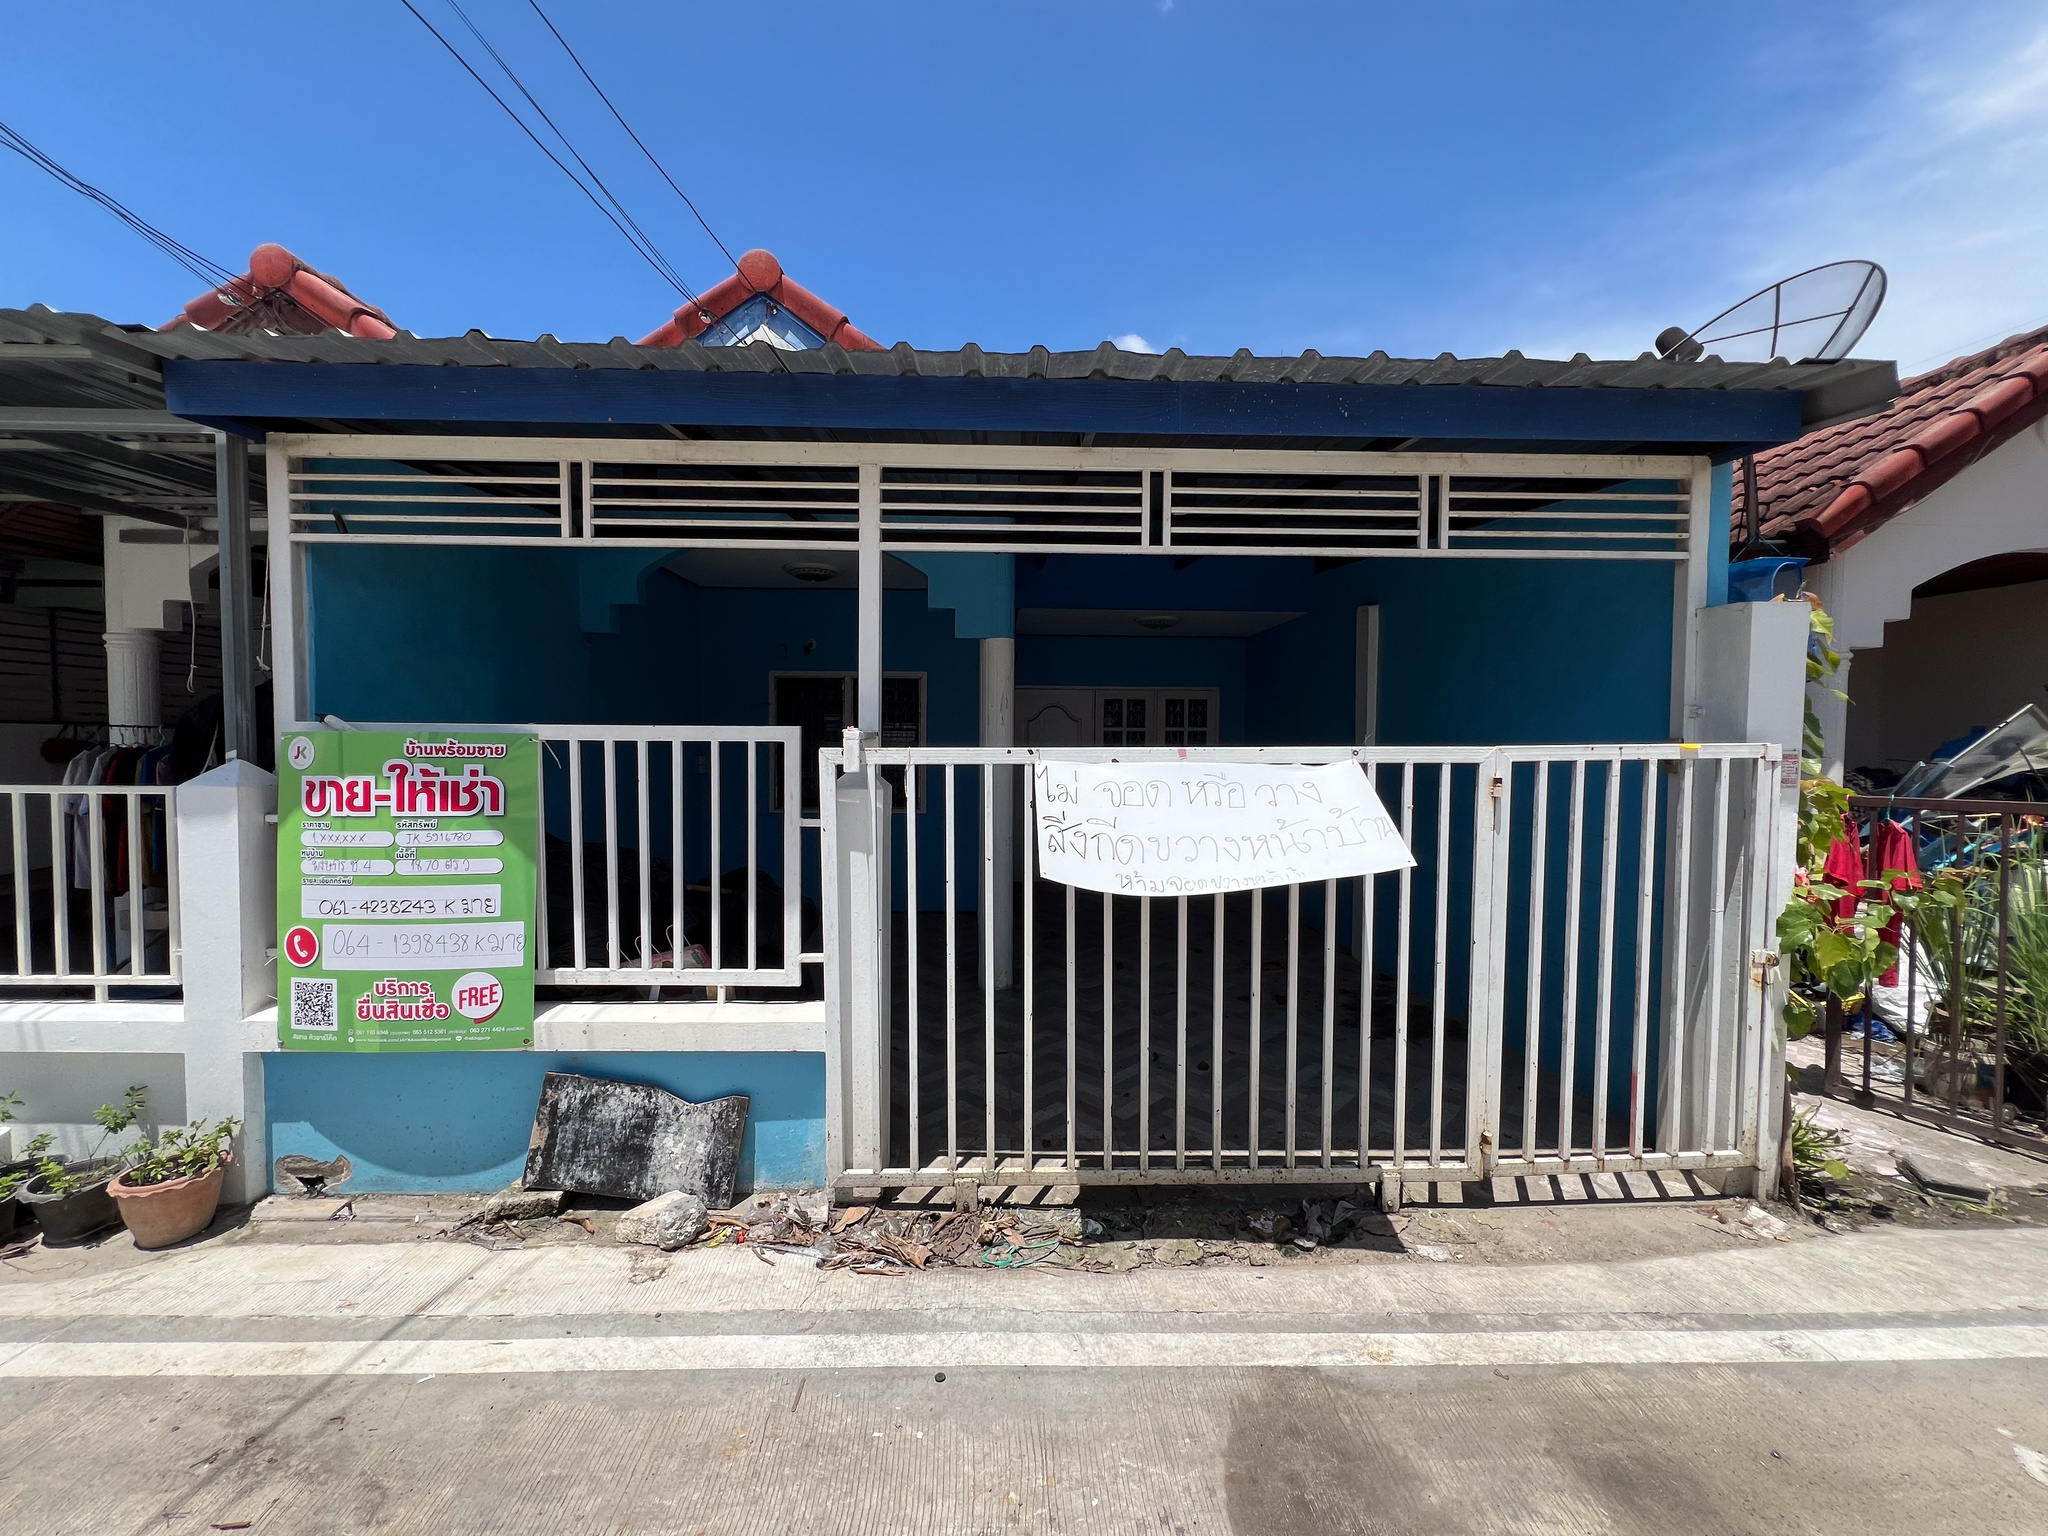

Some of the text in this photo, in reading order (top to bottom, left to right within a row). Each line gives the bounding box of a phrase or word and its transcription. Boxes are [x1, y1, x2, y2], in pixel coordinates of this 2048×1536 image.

[405, 738, 506, 757] บ้านพร้อมขาย
[305, 763, 500, 812] ขาย-ให้เช่า
[1036, 765, 1323, 809] ไม่ จอด หรือ วาง
[396, 819, 437, 829] รหัสทรัพย์
[301, 848, 323, 860] หมู่บ้าน
[396, 848, 415, 859] เนื้อที่
[375, 979, 430, 996] บริการ
[458, 983, 499, 1010] FREE
[357, 994, 450, 1019] ยื่นสินเชื่อ
